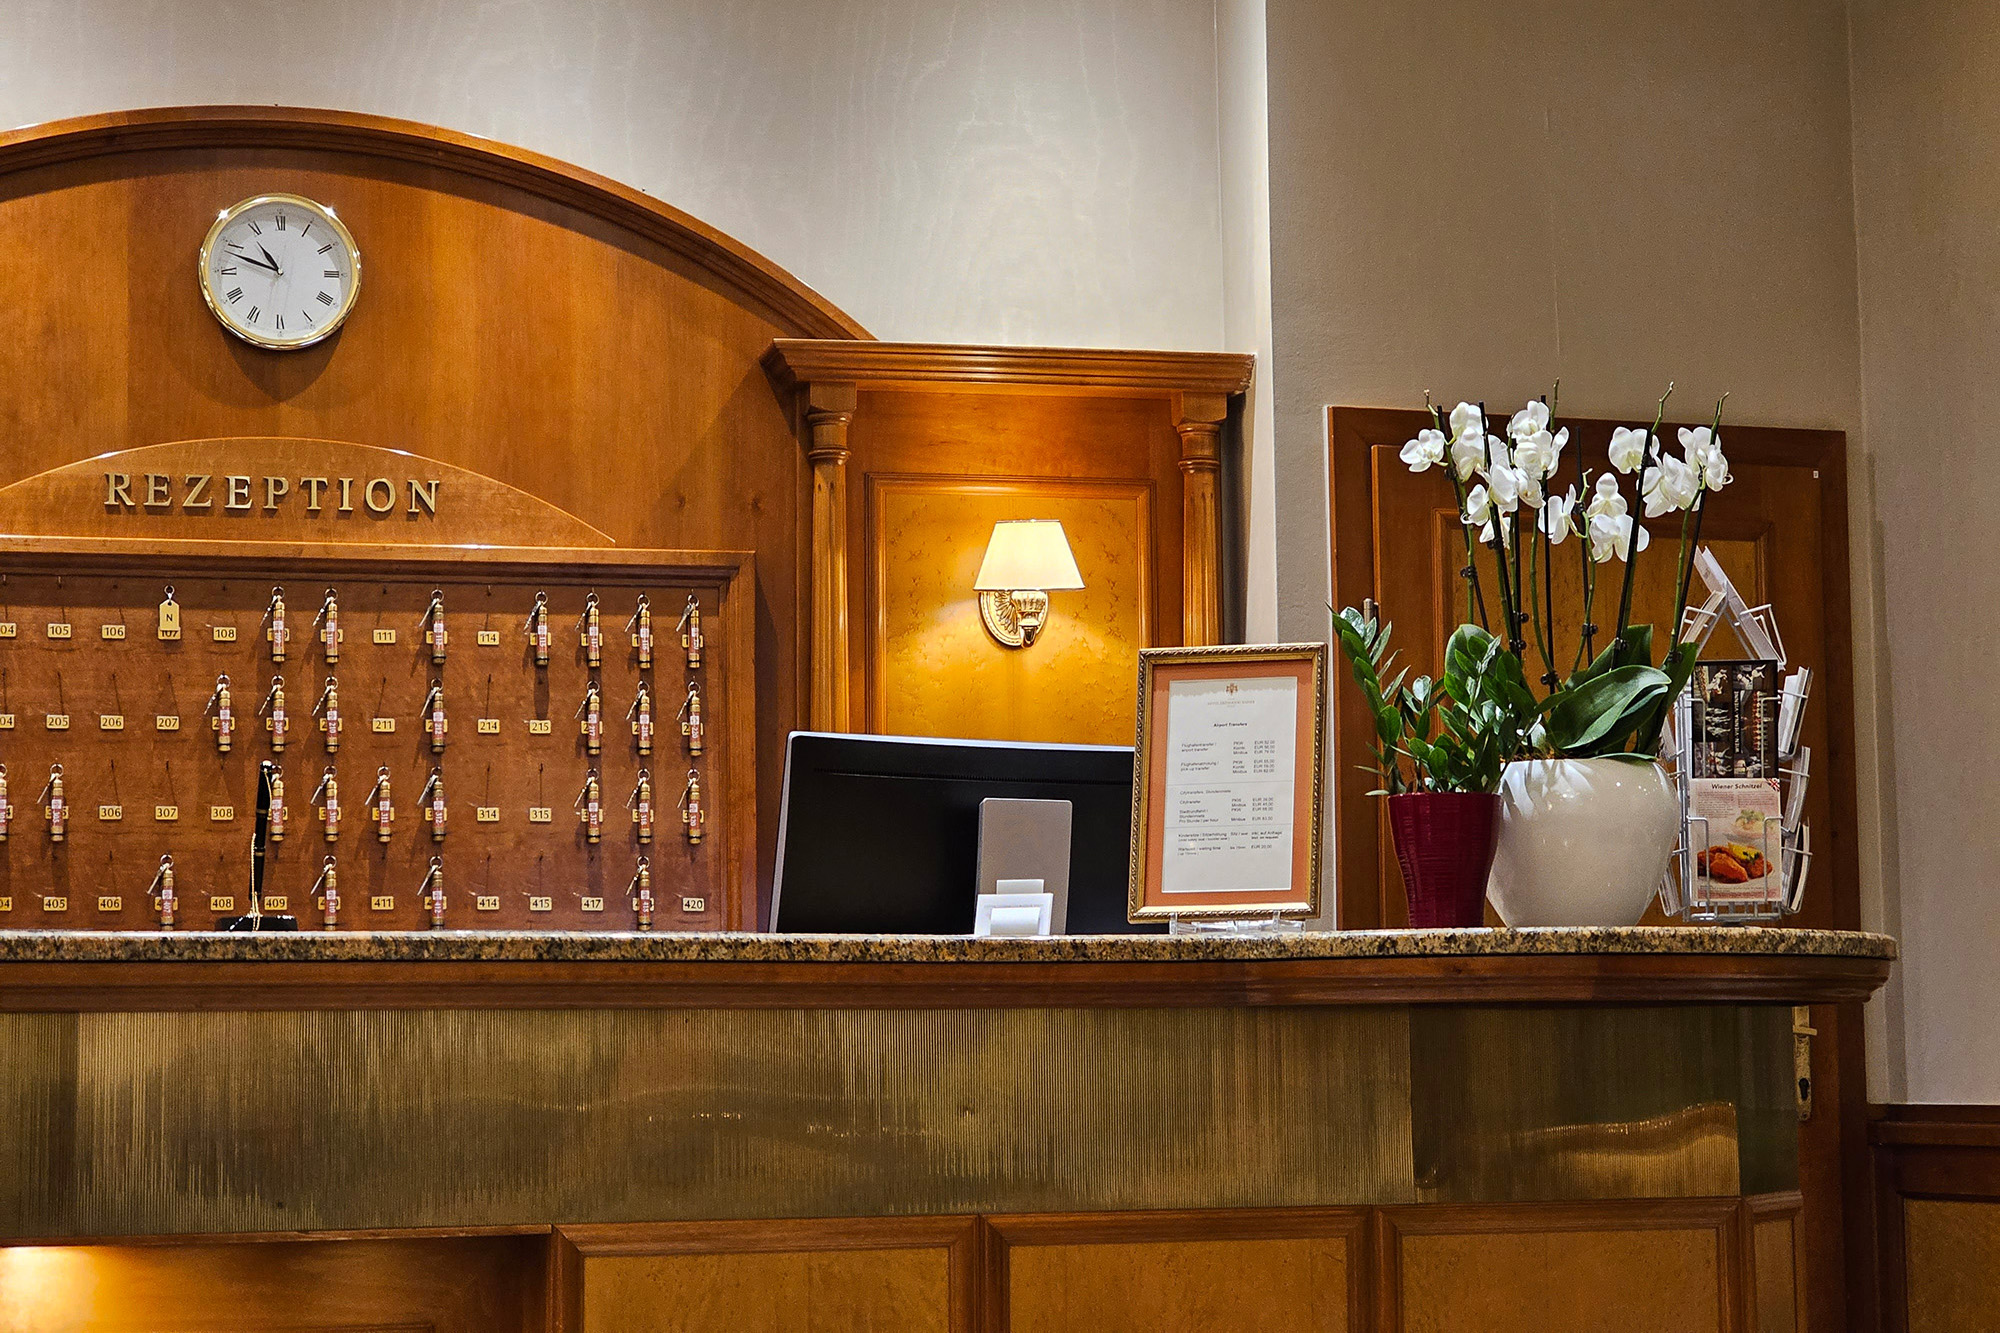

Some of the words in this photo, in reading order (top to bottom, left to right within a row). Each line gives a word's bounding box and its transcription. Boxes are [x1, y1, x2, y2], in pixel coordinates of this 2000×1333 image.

[317, 244, 333, 255] II
[324, 270, 340, 278] III
[103, 472, 440, 513] REZEPTION
[166, 614, 173, 622] N
[0, 625, 15, 635] 04
[49, 625, 69, 636] 105
[104, 626, 124, 637] 106
[216, 629, 235, 638] 108
[377, 631, 392, 641] 111
[480, 633, 497, 643] 114
[0, 716, 13, 726] 04
[48, 717, 69, 726] 205
[102, 717, 122, 727] 206
[158, 718, 178, 727] 207
[375, 720, 392, 730] 211
[480, 721, 498, 731] 214
[328, 722, 337, 734] 210
[434, 722, 442, 735] 212
[531, 722, 549, 731] 215
[588, 725, 596, 737] 217
[691, 726, 699, 739] 220
[46, 807, 68, 817] 35
[101, 808, 121, 817] 306
[156, 808, 177, 817] 307
[212, 808, 233, 818] 308
[479, 810, 497, 819] 314
[531, 810, 550, 819] 315
[381, 812, 389, 823] 311
[435, 811, 443, 824] 312
[590, 813, 598, 825] 317
[45, 899, 66, 909] 405
[100, 899, 120, 909] 406
[212, 899, 232, 908] 408
[265, 898, 286, 908] 409
[373, 898, 392, 908] 411
[479, 899, 498, 908] 414
[532, 899, 550, 908] 415
[583, 899, 602, 908] 417
[684, 899, 703, 909] 420
